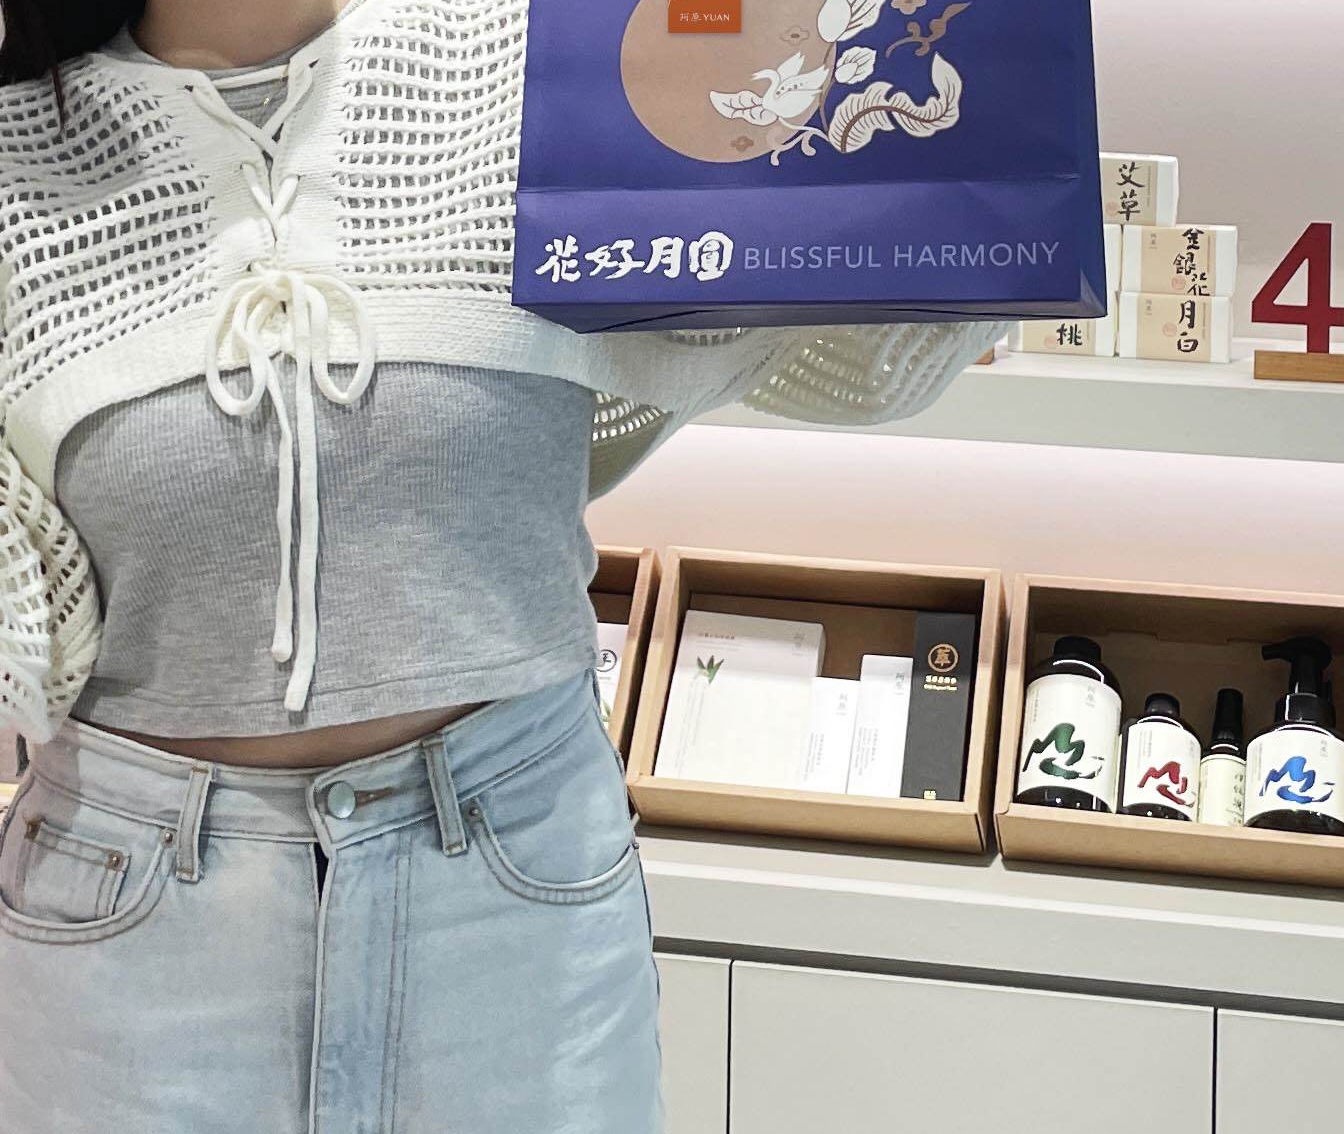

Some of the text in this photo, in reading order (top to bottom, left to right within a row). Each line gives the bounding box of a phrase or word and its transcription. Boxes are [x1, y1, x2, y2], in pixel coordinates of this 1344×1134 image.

[703, 13, 731, 23] YUAN
[1116, 161, 1145, 222] 艾草
[535, 230, 1061, 284] 花好月圓 BLISSFUL HARMONY
[1172, 227, 1211, 297] 金銀花
[1056, 323, 1083, 346] 桃
[1176, 299, 1199, 353] 月白
